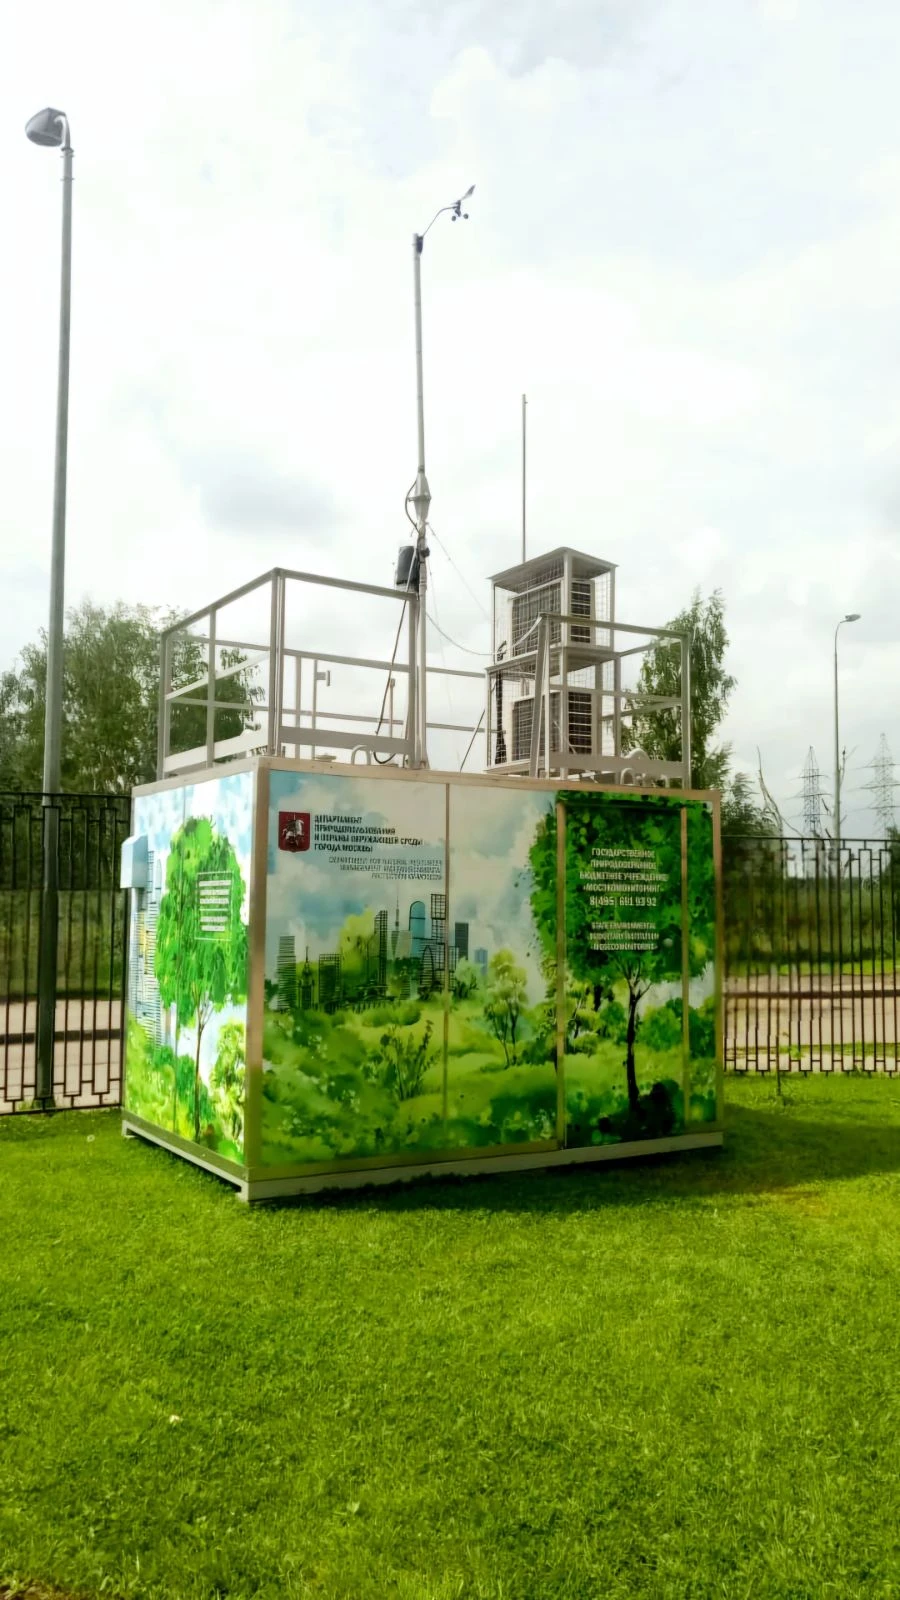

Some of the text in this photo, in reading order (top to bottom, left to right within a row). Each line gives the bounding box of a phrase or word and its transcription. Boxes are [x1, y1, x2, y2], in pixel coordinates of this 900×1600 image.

[314, 843, 373, 853] ГОРОДА МОСКВЫ
[591, 847, 655, 858] ГОСУДАРСТВЕННОЕ
